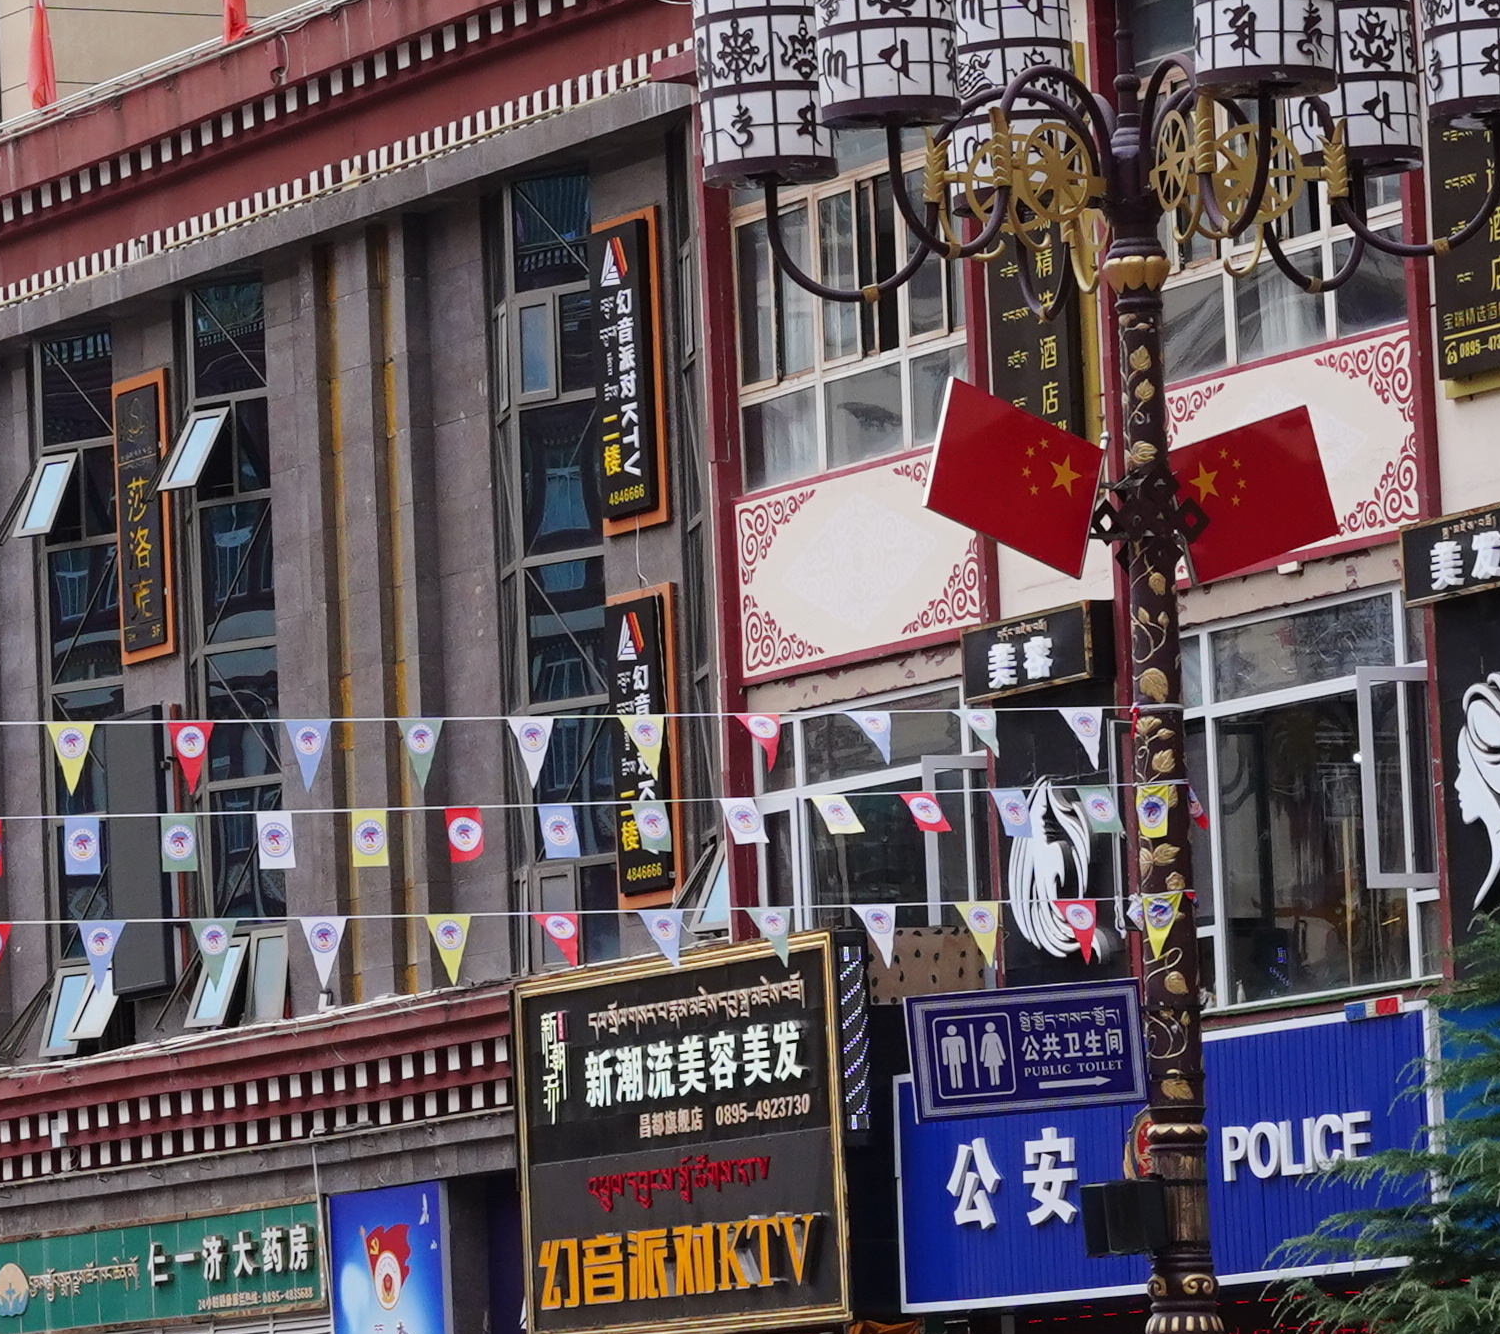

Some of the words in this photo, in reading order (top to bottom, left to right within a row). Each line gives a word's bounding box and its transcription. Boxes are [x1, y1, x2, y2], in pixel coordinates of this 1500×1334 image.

[602, 413, 622, 477] 二楼
[608, 483, 645, 506] 4846666
[987, 635, 1054, 689] 美容
[626, 862, 663, 882] 4846666
[584, 1020, 804, 1109] 新潮流美容美发
[1020, 1027, 1124, 1062] 公共卫生间
[1023, 1063, 1072, 1078] PUBLIC
[1076, 1059, 1124, 1073] TOILET
[639, 1105, 704, 1139] 昌都旗舰店
[715, 1093, 811, 1127] 0895-4923730
[1221, 1109, 1374, 1184] POLICE
[945, 1127, 1081, 1231] 公安
[147, 1223, 315, 1288] 仁一济大药房
[538, 1213, 816, 1310] 幻音派对KTV
